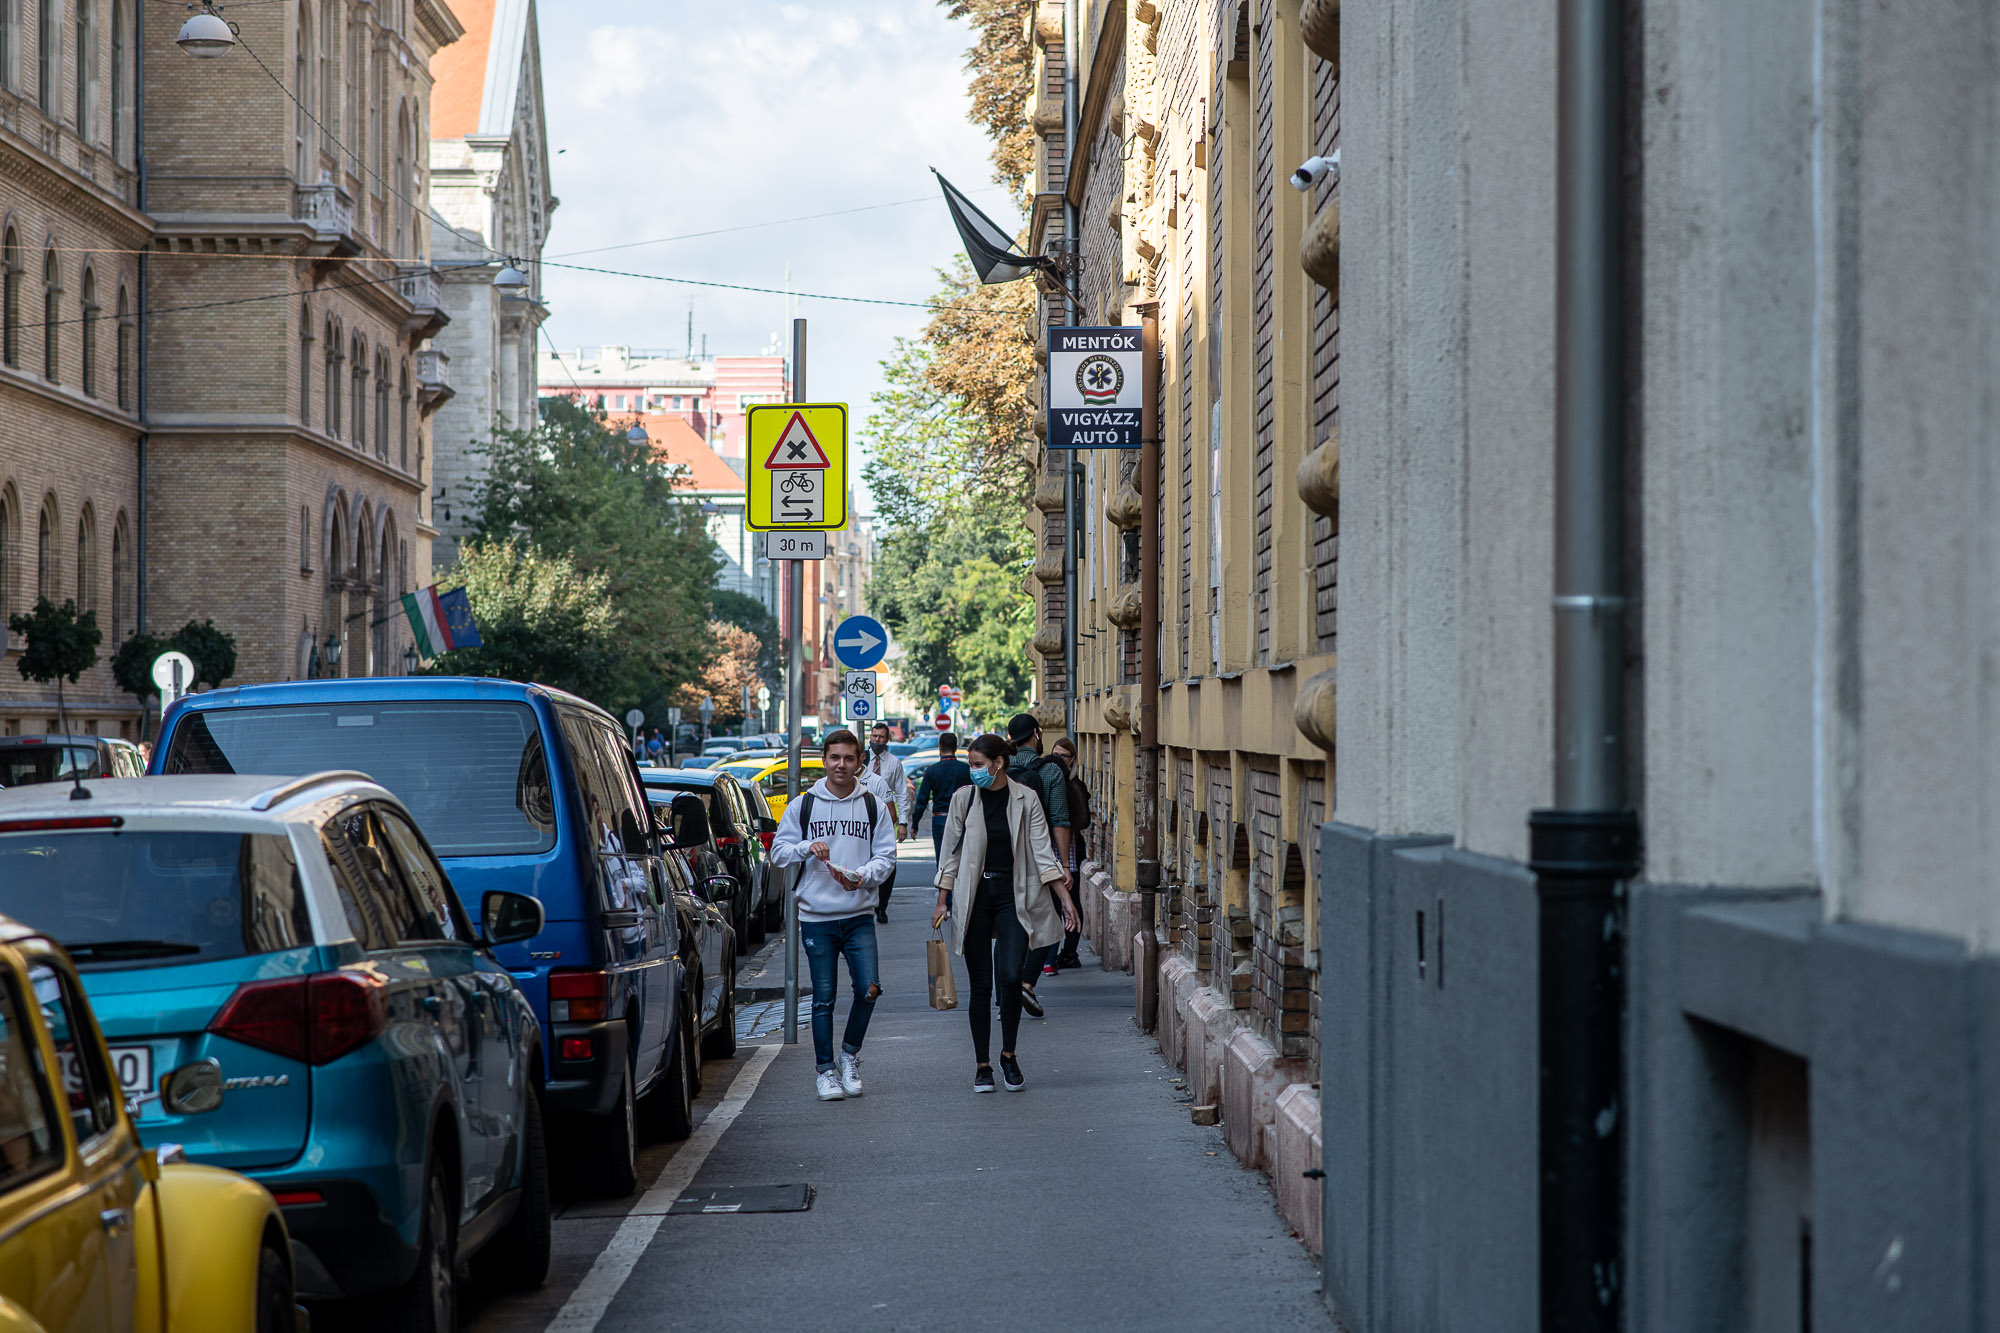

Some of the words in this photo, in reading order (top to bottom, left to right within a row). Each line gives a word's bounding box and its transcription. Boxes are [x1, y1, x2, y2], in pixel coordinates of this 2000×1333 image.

[1062, 334, 1136, 349] MENTŐK
[1061, 410, 1139, 427] VIGYÁZZ,
[1071, 428, 1119, 444] AUTÓ
[780, 538, 796, 551] 30
[800, 541, 814, 551] m
[810, 820, 838, 840] NEW
[840, 820, 870, 840] YORK
